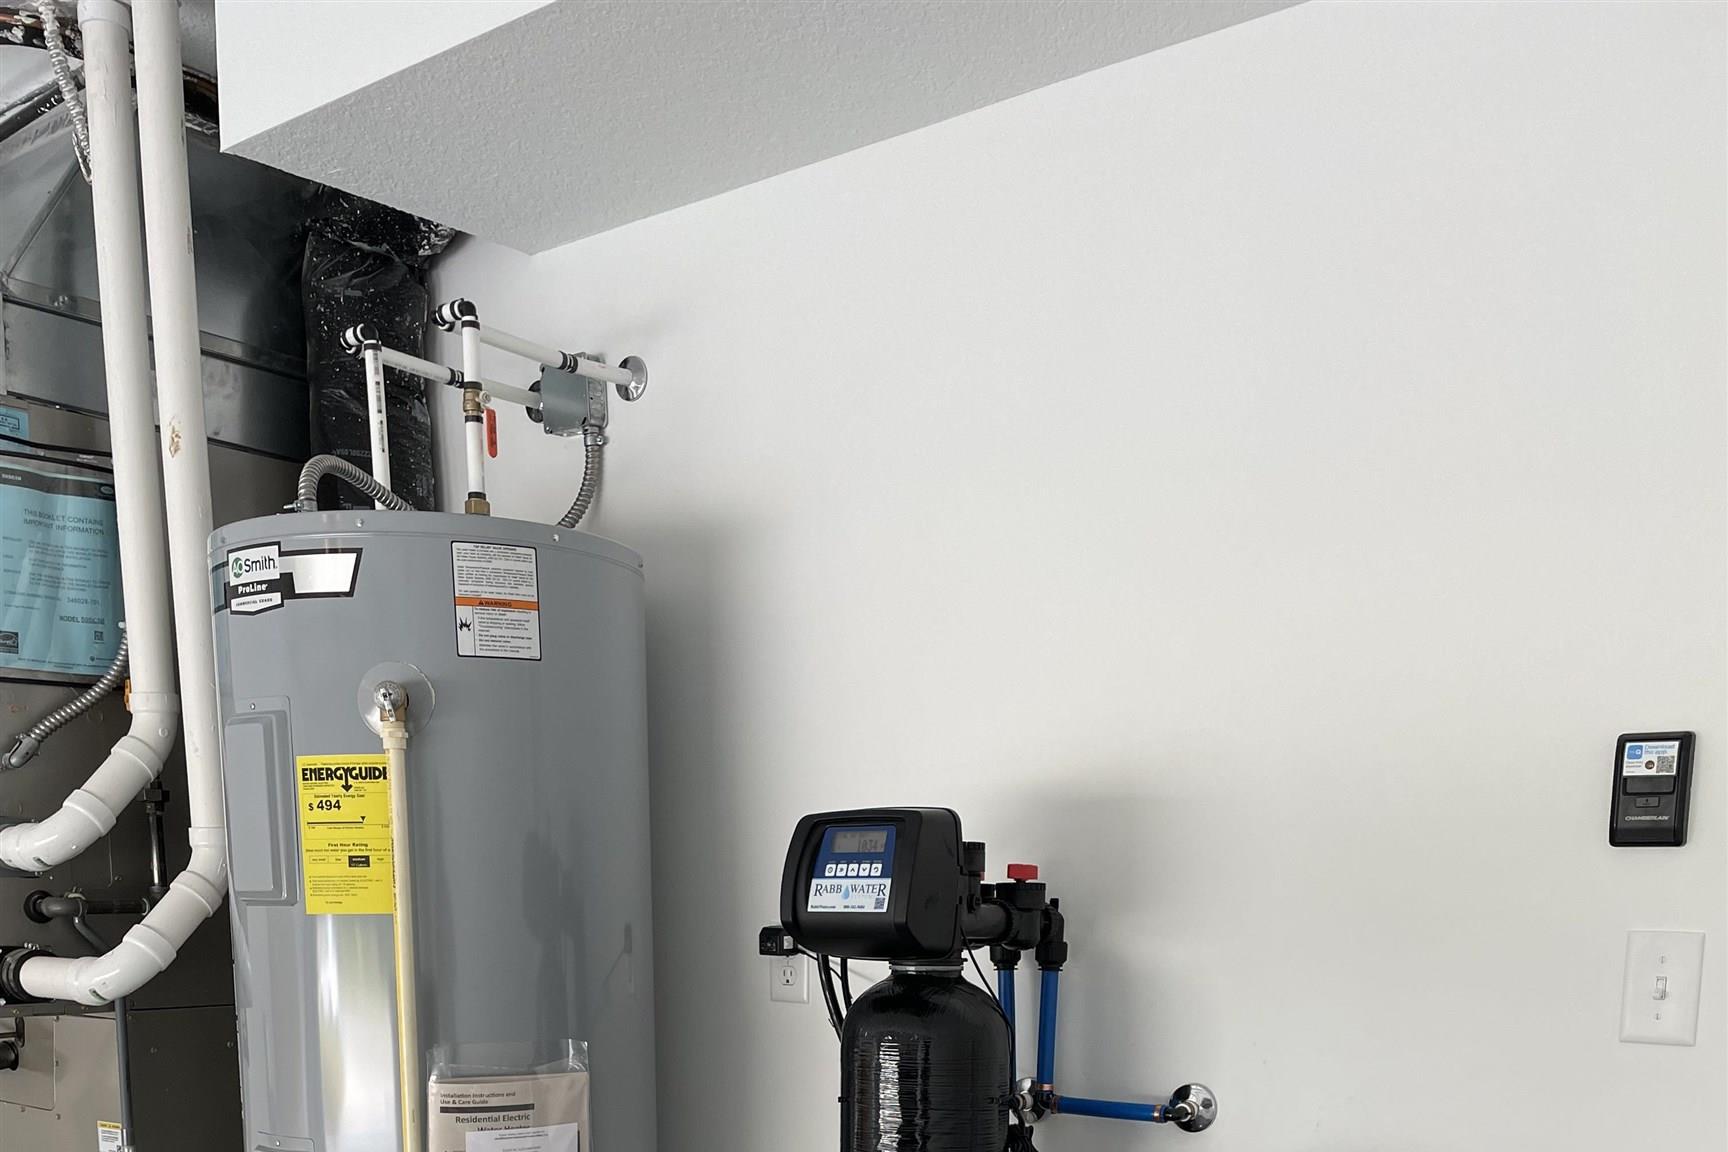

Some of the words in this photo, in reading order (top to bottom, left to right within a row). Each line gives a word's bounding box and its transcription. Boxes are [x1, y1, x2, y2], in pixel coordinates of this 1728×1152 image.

[244, 555, 276, 573] Smith
[238, 583, 268, 594] ProLine
[317, 799, 342, 811] 494
[814, 883, 842, 896] RABB
[850, 883, 887, 896] WATER
[455, 1115, 500, 1123] Residential
[502, 1113, 530, 1121] Electric
